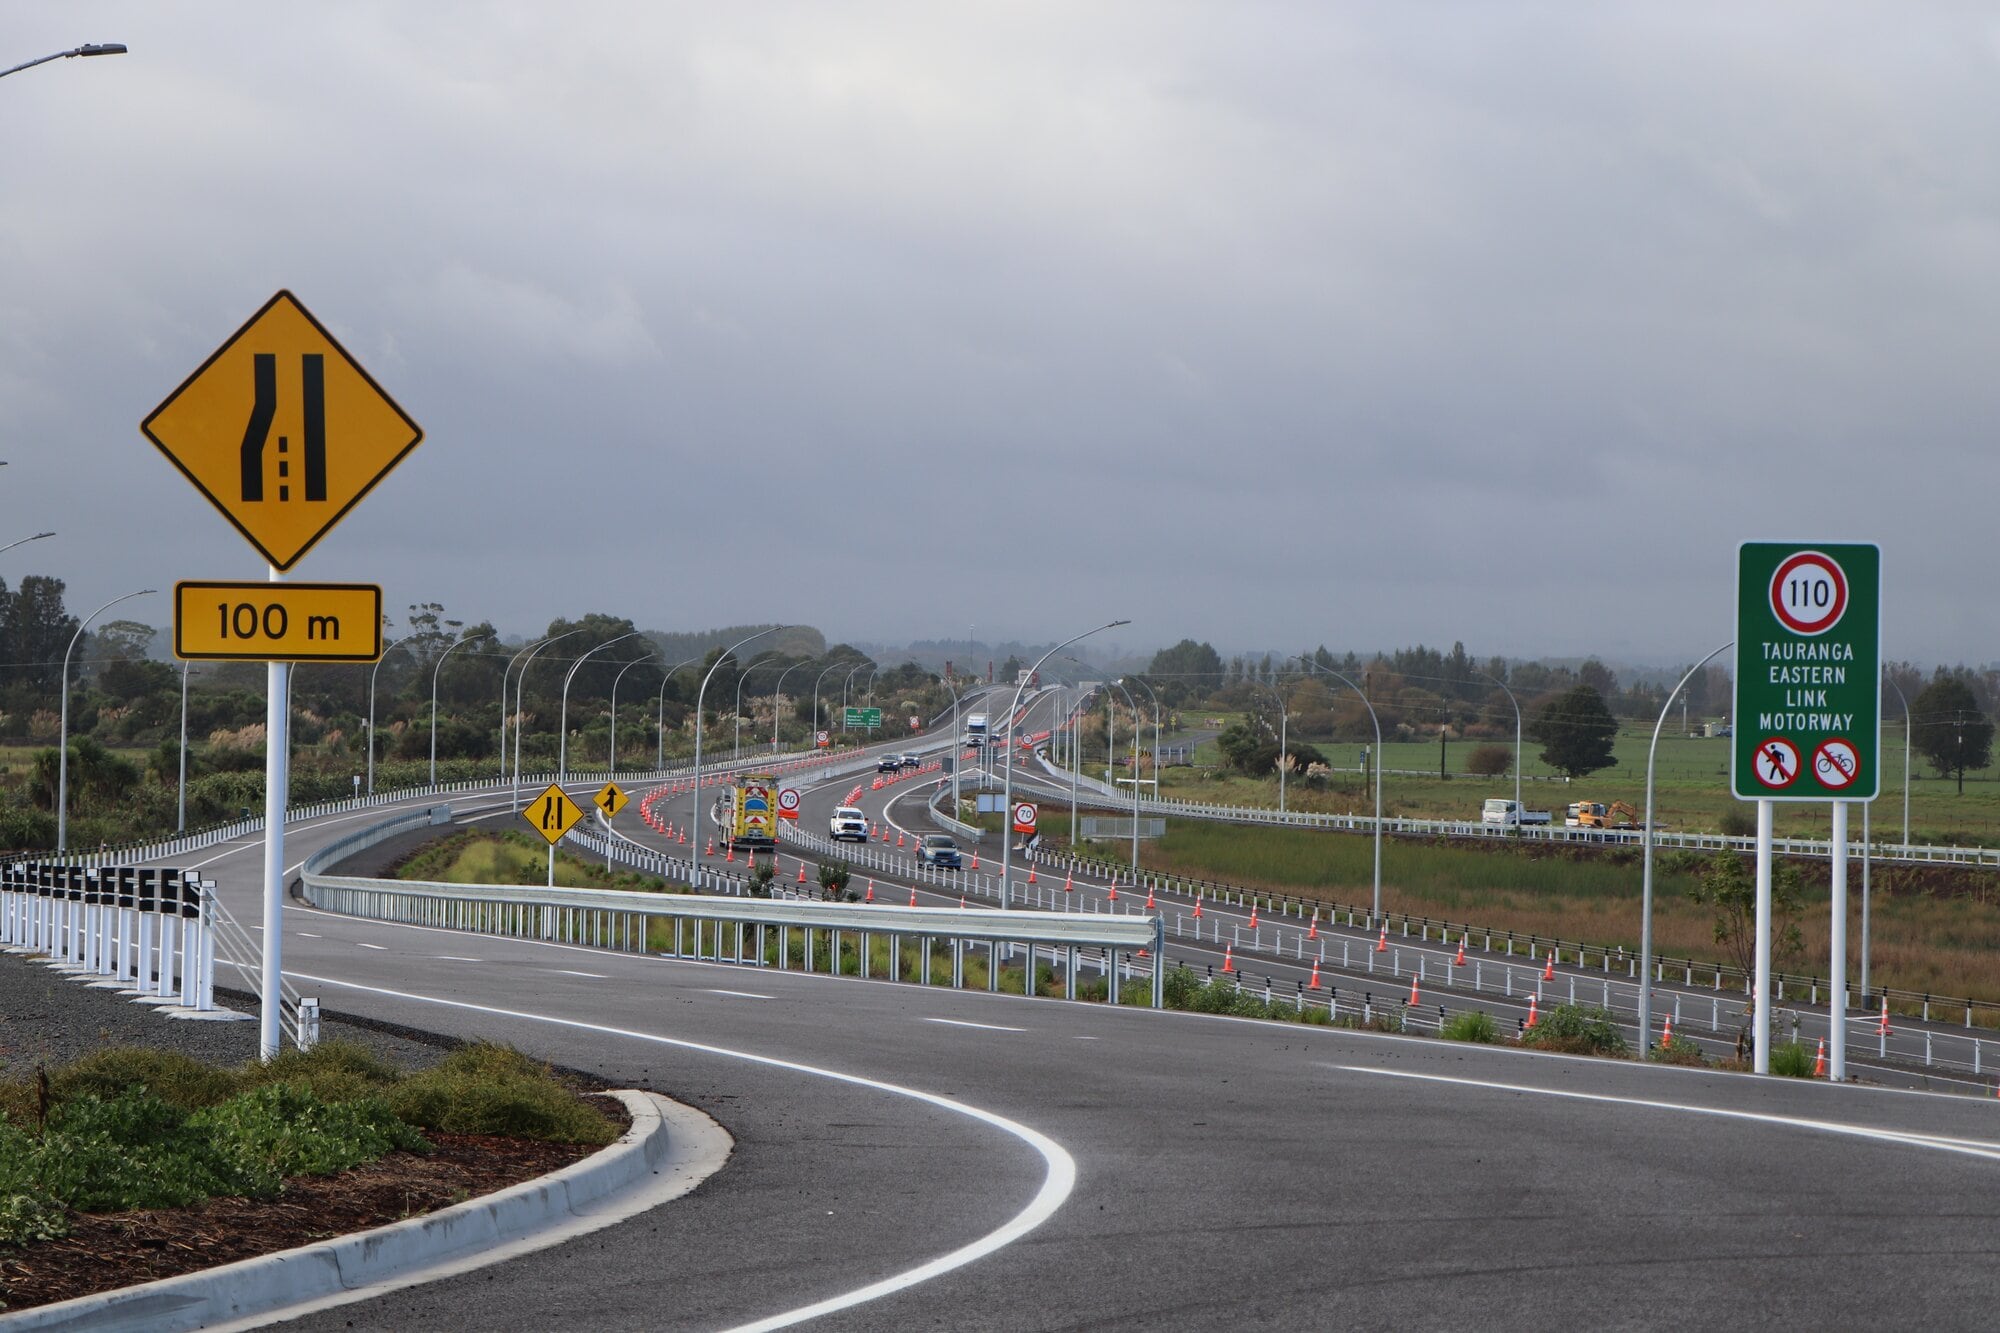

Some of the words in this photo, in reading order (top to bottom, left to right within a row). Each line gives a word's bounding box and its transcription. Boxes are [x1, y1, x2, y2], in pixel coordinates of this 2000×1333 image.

[1791, 580, 1829, 607] 110
[218, 603, 288, 640] 100
[308, 615, 339, 640] m
[1762, 643, 1853, 661] TAURANGA
[1770, 666, 1845, 684] EASTERN
[1787, 690, 1827, 707] LINK
[1760, 713, 1853, 731] MOTORWAY
[784, 795, 795, 804] 70
[1020, 809, 1032, 818] 70
